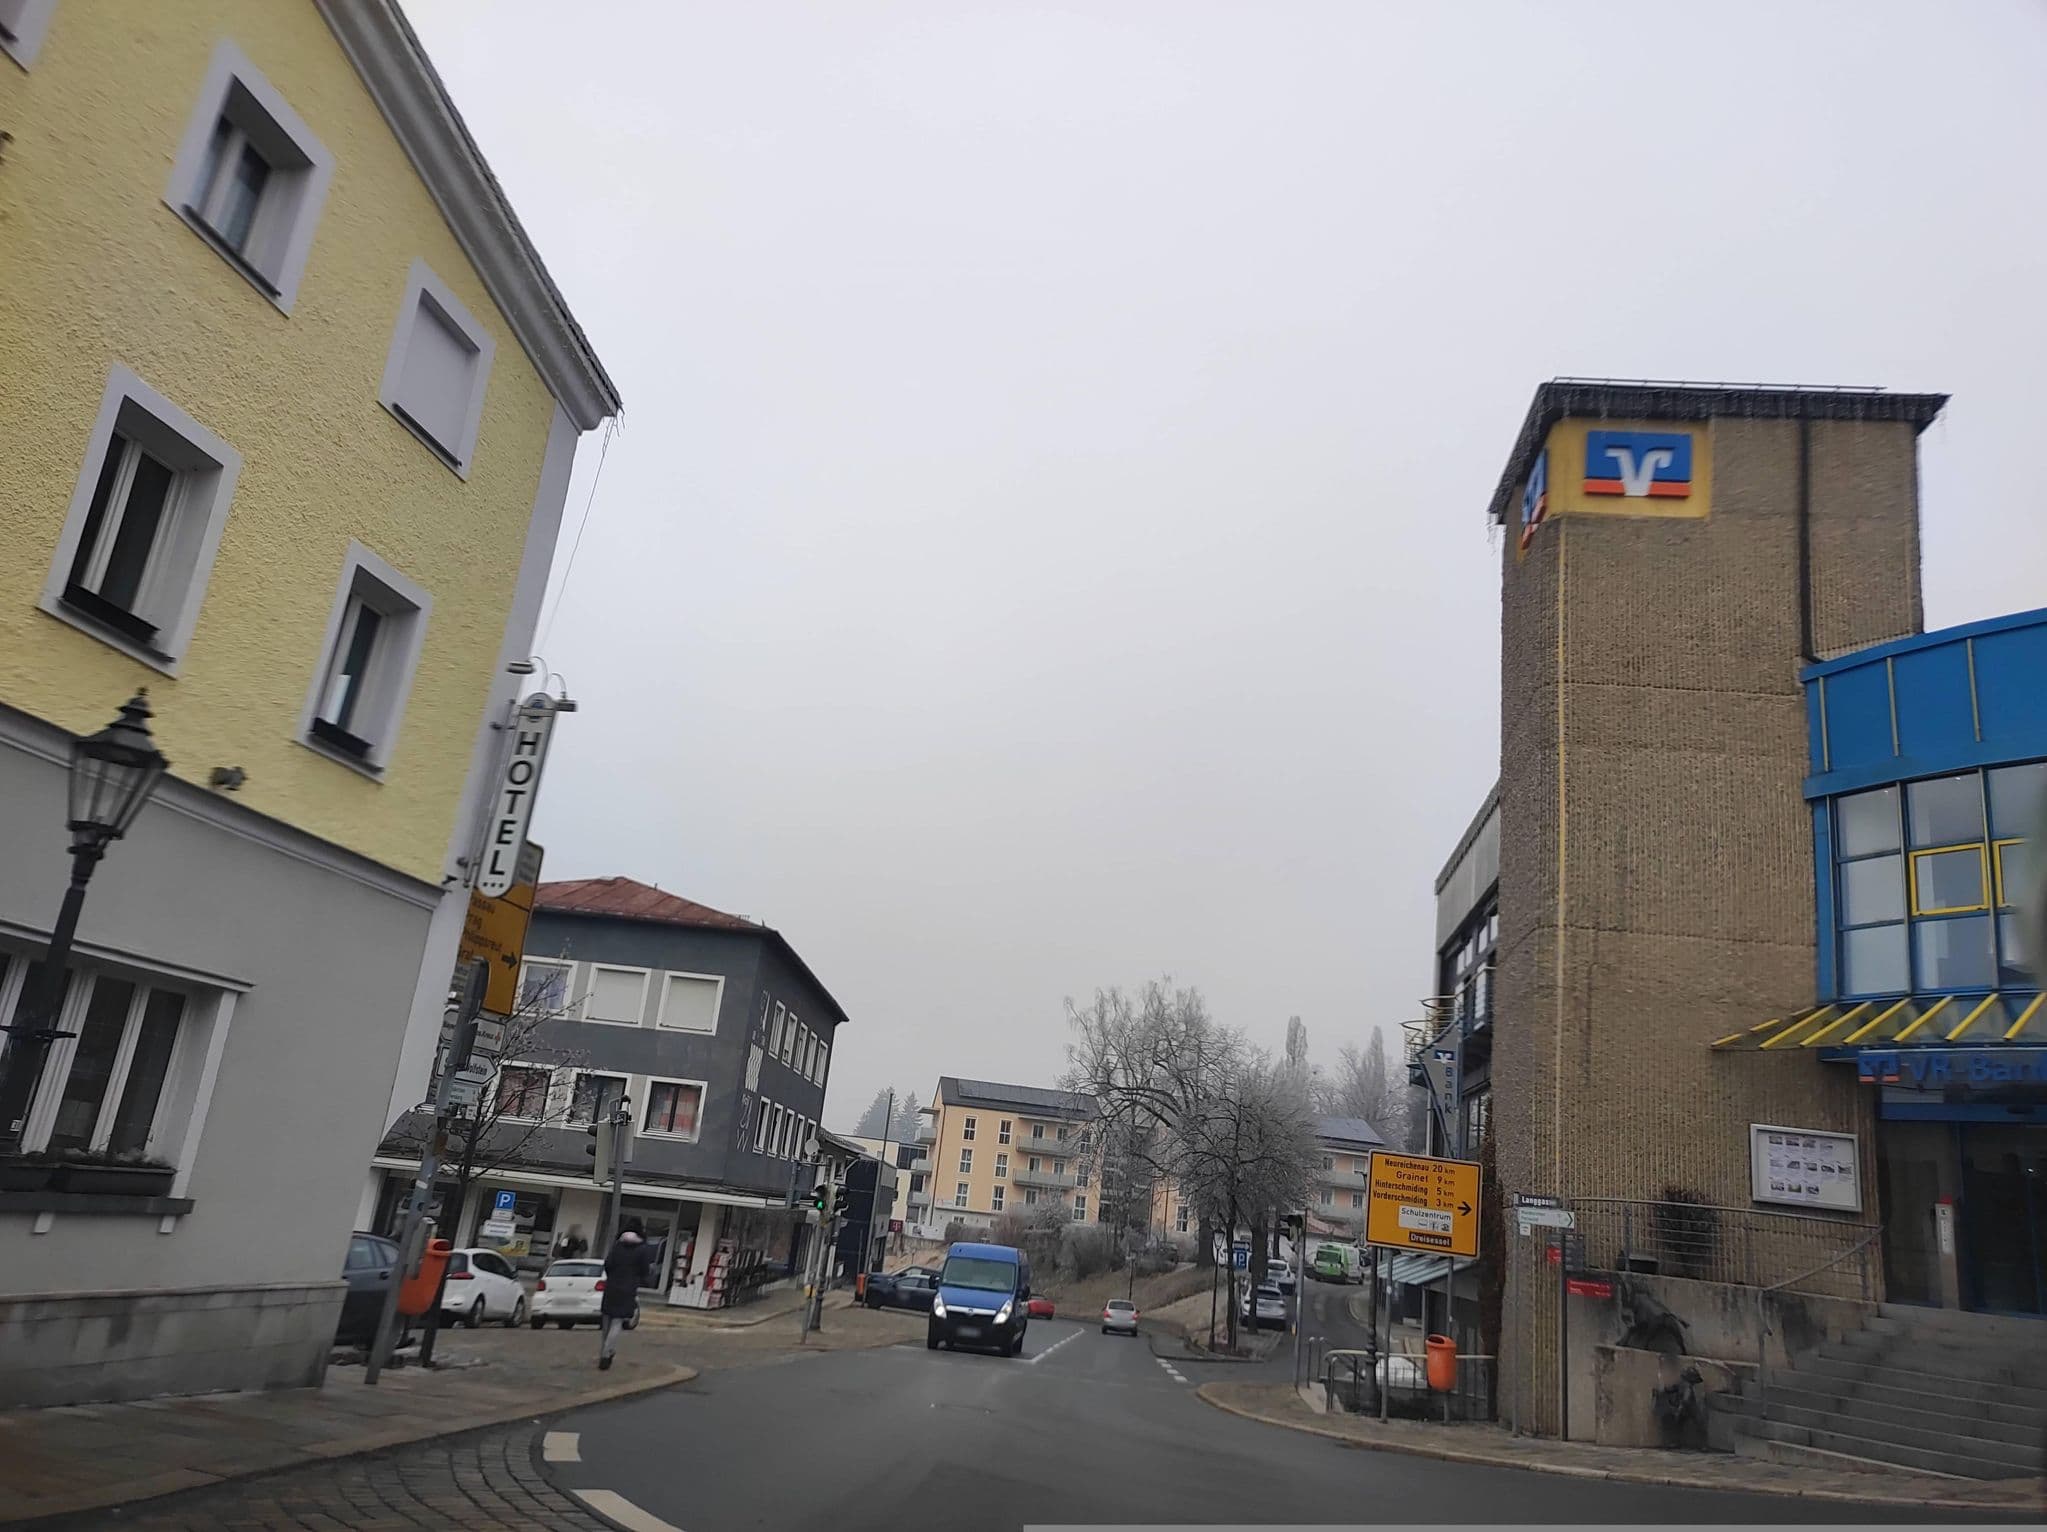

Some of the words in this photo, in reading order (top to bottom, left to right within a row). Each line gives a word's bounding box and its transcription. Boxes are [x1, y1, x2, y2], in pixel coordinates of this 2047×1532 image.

[489, 731, 542, 877] HOTEL
[1444, 1066, 1453, 1114] Bank
[1384, 1158, 1430, 1172] Neureichenau
[1432, 1164, 1443, 1173] 20
[1444, 1167, 1456, 1175] km
[1396, 1171, 1429, 1183] Grainet
[1437, 1175, 1443, 1183] 9
[1444, 1178, 1455, 1186] km
[1375, 1179, 1428, 1196] Hinterschmiding
[1436, 1187, 1442, 1196] 5
[1443, 1190, 1455, 1198] km
[499, 1193, 511, 1207] P
[1373, 1190, 1428, 1207] Vorderschmiding
[1435, 1198, 1441, 1207] 3
[1443, 1201, 1454, 1209] km
[1401, 1207, 1452, 1222] Schulzentrum
[1410, 1233, 1451, 1247] Dreisessel
